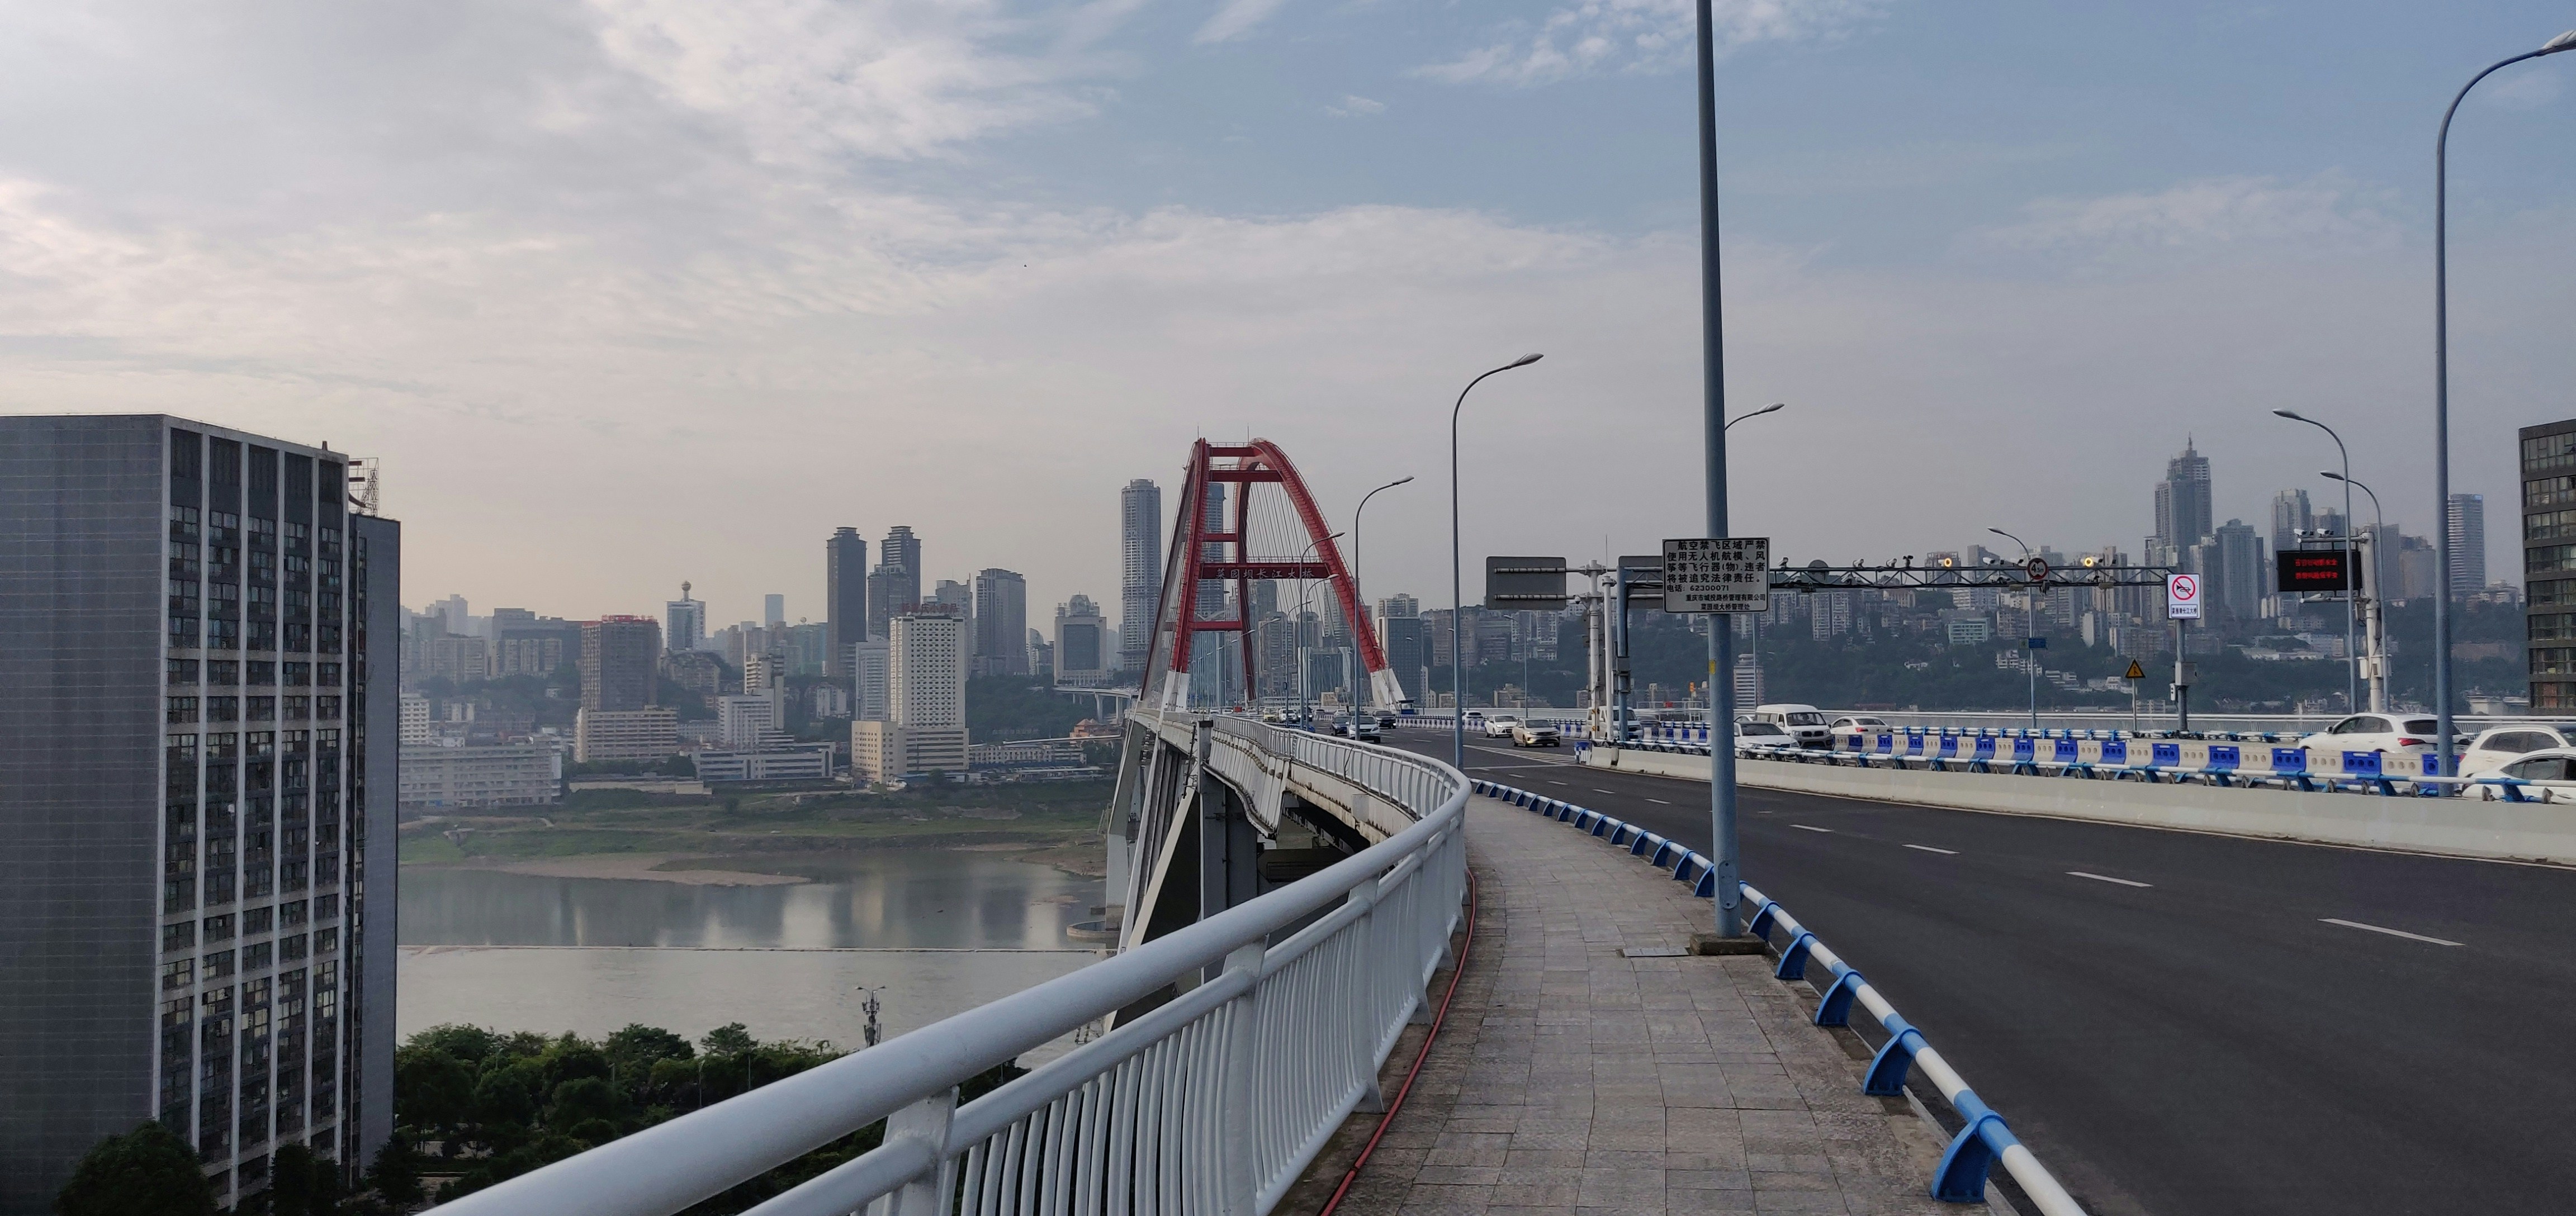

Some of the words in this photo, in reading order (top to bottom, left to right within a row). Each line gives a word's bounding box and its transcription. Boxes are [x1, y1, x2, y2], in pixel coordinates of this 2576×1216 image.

[1678, 540, 1765, 550] 航空禁飞区域严禁
[1667, 552, 1765, 562] 使用无人机航模、风
[1216, 567, 1315, 579] 菜园坝长江大桥
[1667, 573, 1760, 583] 将被追究法律责任。
